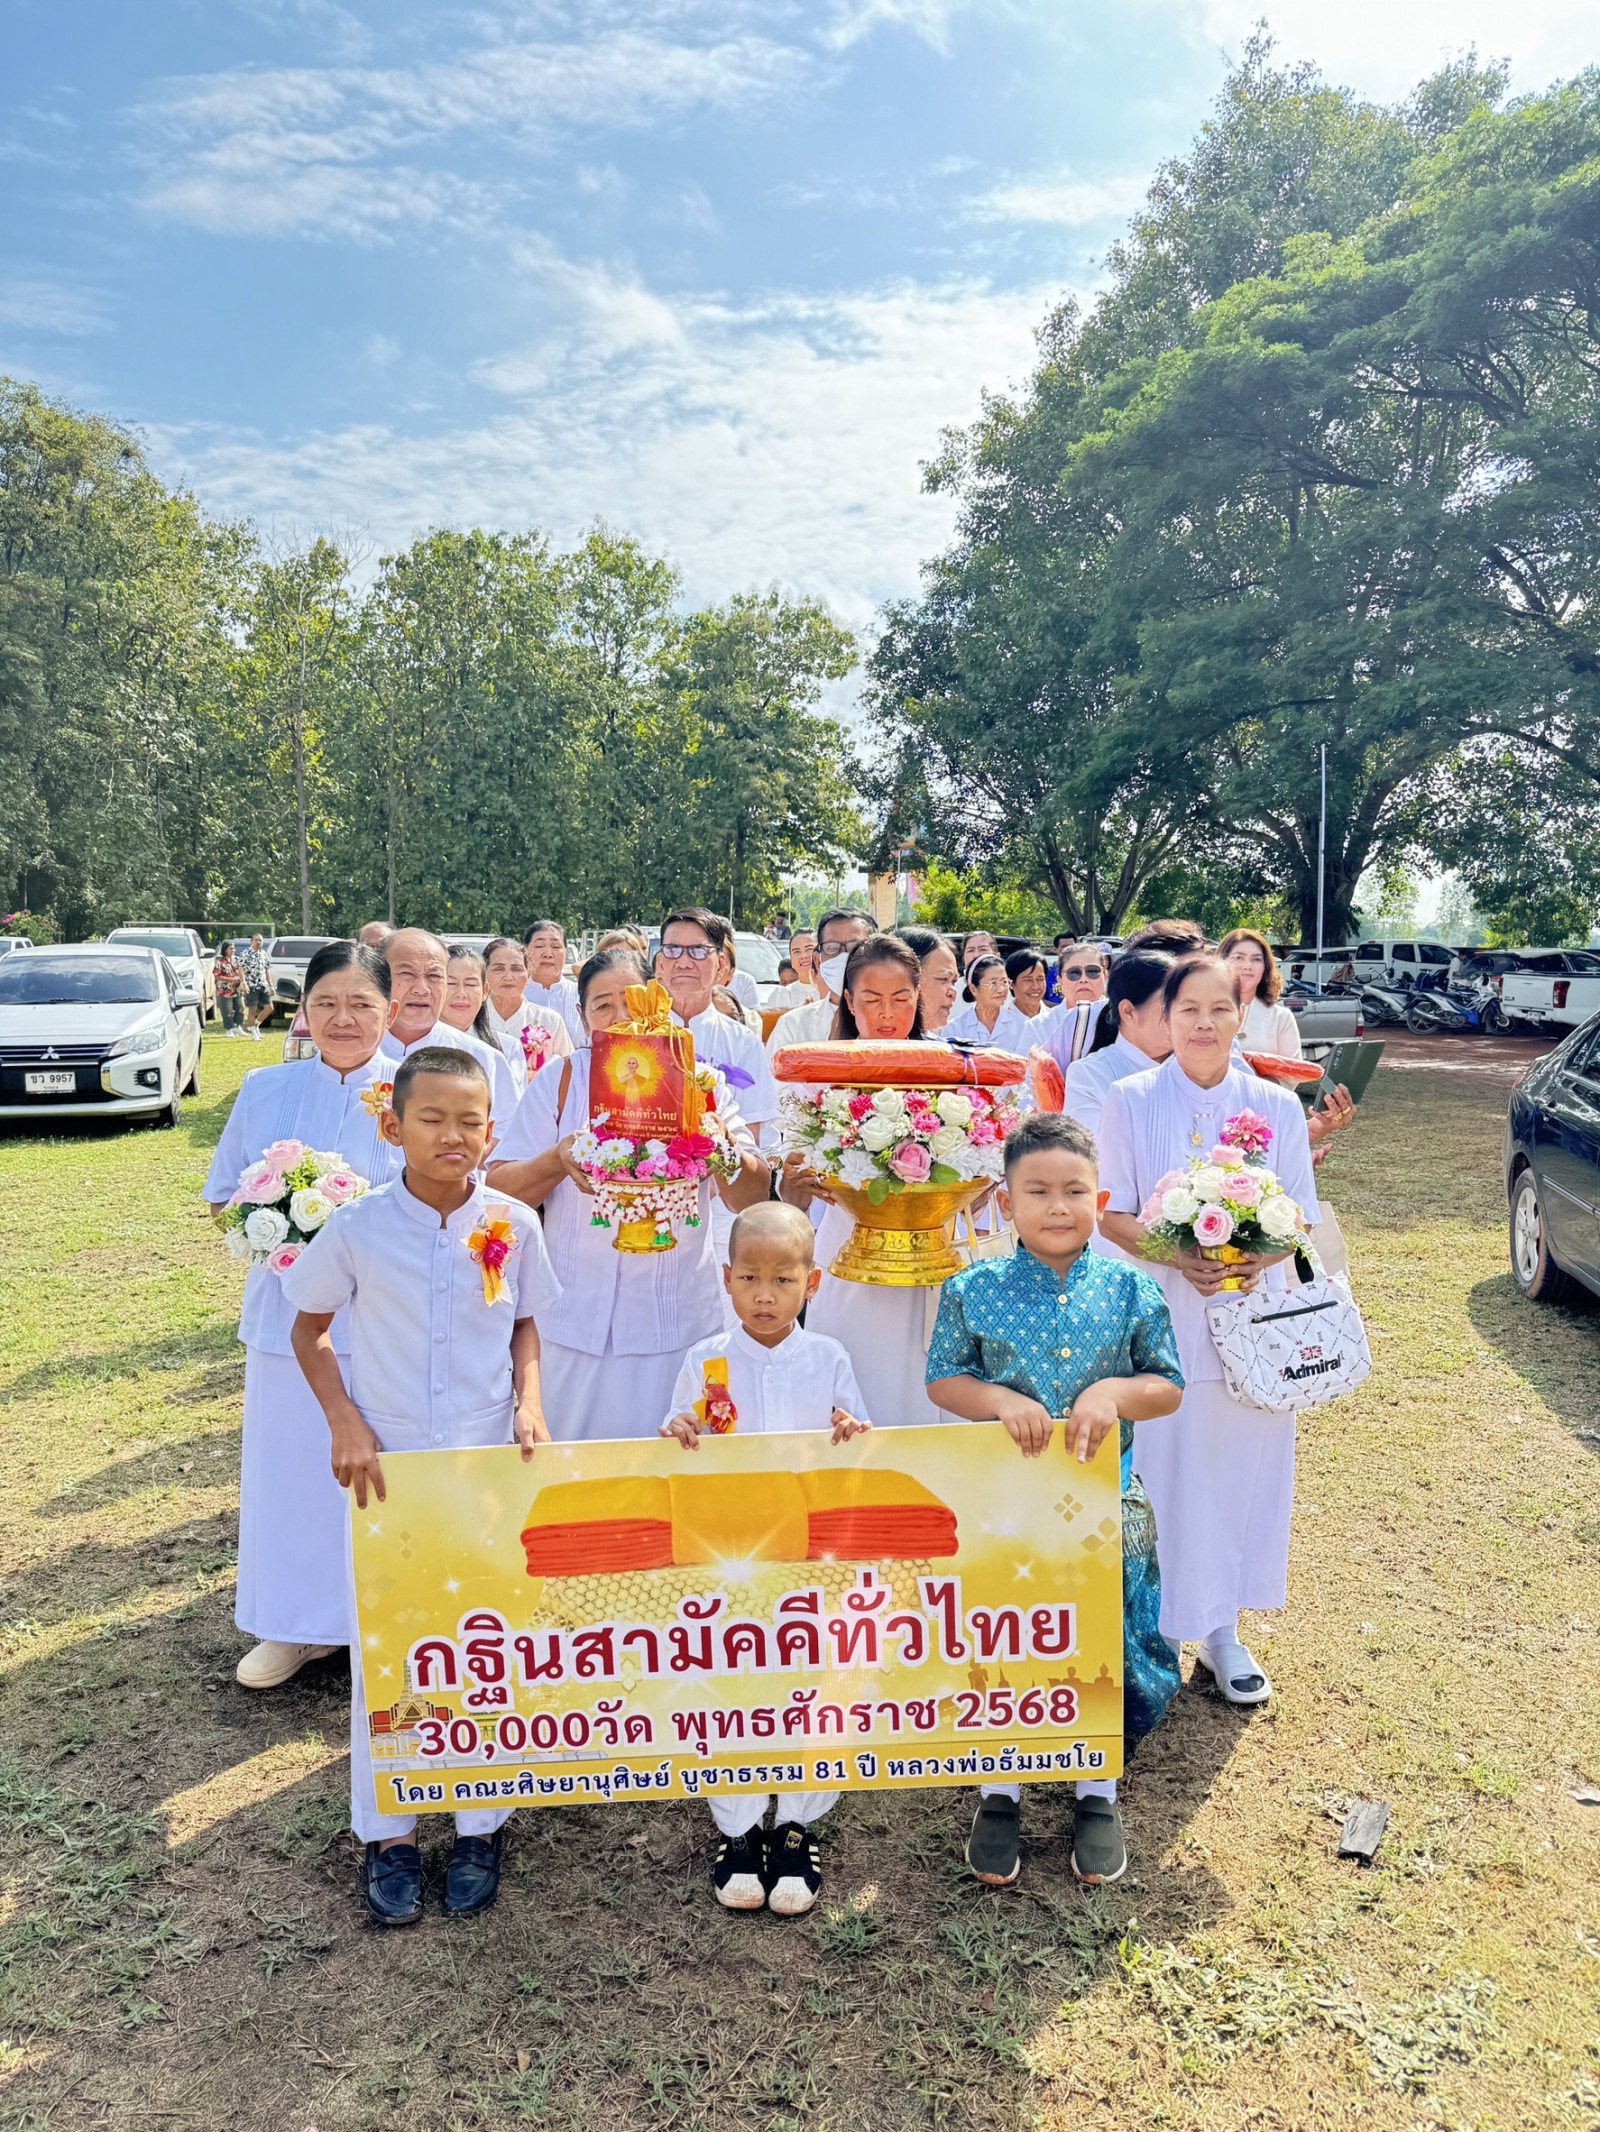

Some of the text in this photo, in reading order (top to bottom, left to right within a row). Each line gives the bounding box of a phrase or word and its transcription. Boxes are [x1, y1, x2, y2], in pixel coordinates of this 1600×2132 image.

[50, 1073, 73, 1083] 9957
[1282, 1354, 1341, 1382] Admiral
[413, 1571, 1070, 1706] กฐินสามัคคีทั่วไทย
[417, 1688, 1077, 1760] 30,000วัด พุทธศักราช 2568
[393, 1743, 1104, 1802] โดย คณะศิษยานุศิษย์ บูชาธรรม 81 ปี หลวงพ่อธัมมชโย
